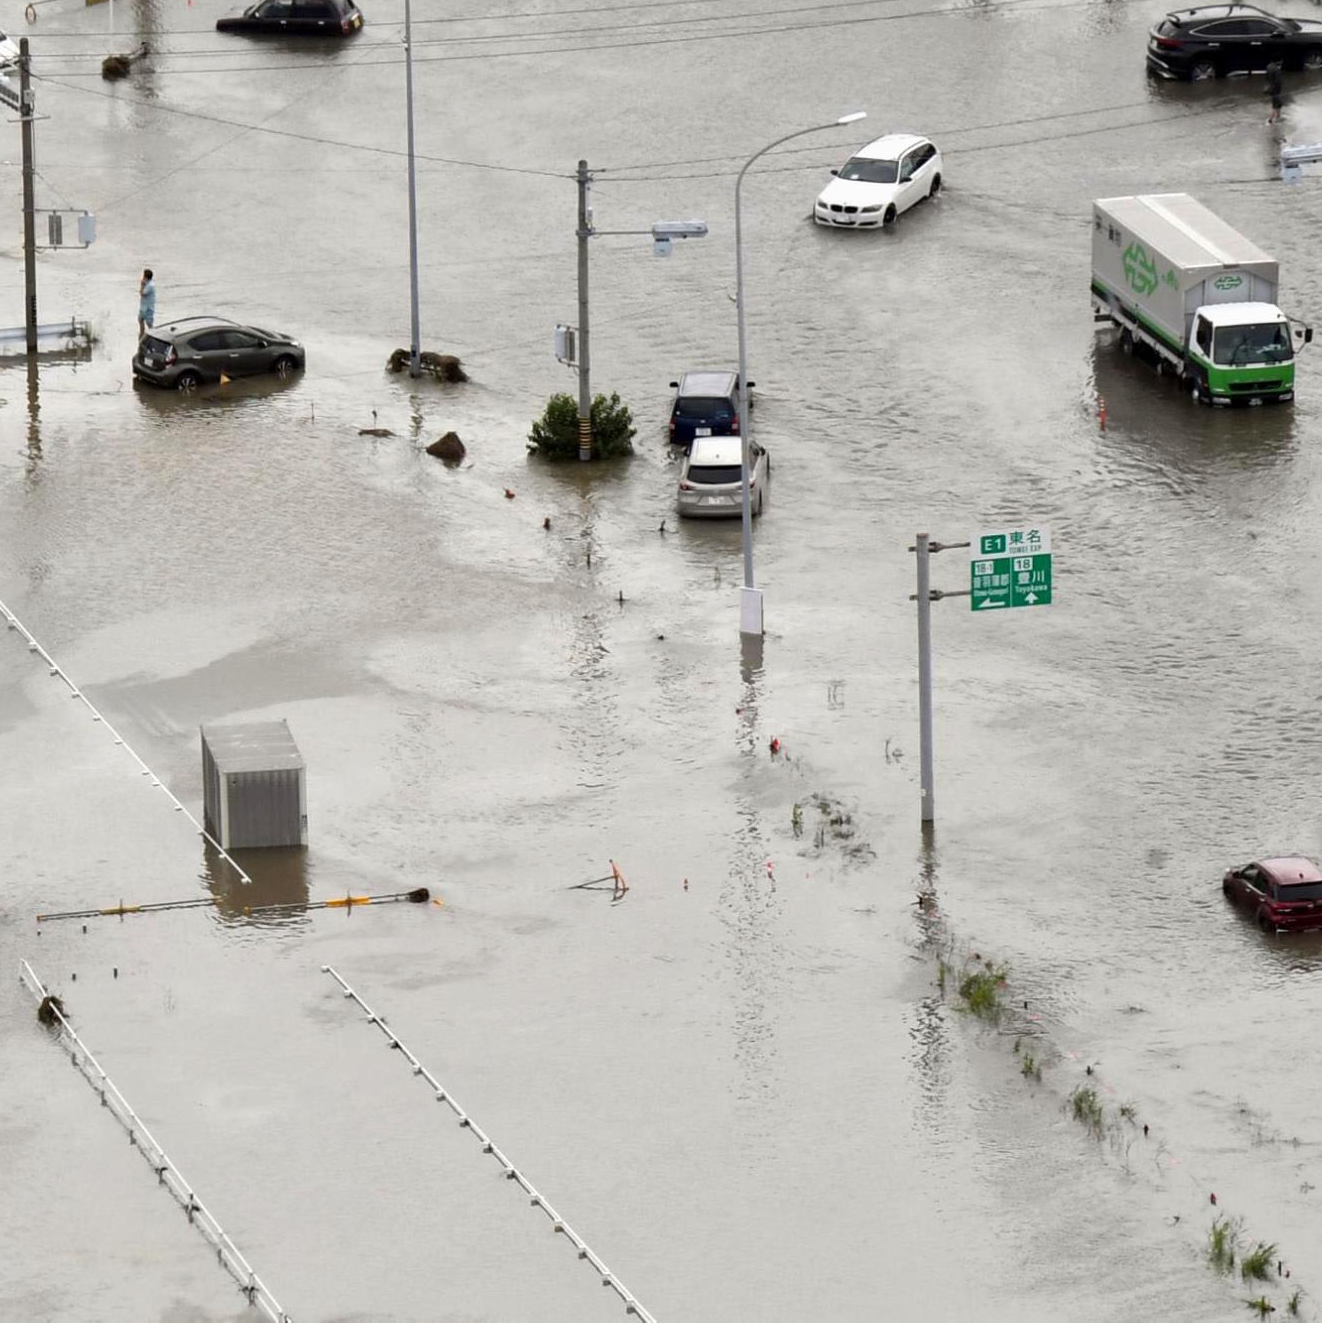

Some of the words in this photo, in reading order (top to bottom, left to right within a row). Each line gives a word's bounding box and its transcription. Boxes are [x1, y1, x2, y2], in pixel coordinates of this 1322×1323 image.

[1009, 529, 1041, 545] 東名
[985, 538, 1002, 551] E1
[1009, 546, 1028, 554] TOMEI
[1030, 544, 1041, 552] EXP
[1016, 558, 1031, 570] 18
[1018, 570, 1045, 584] 豊川
[1014, 584, 1048, 594] Toyokawa
